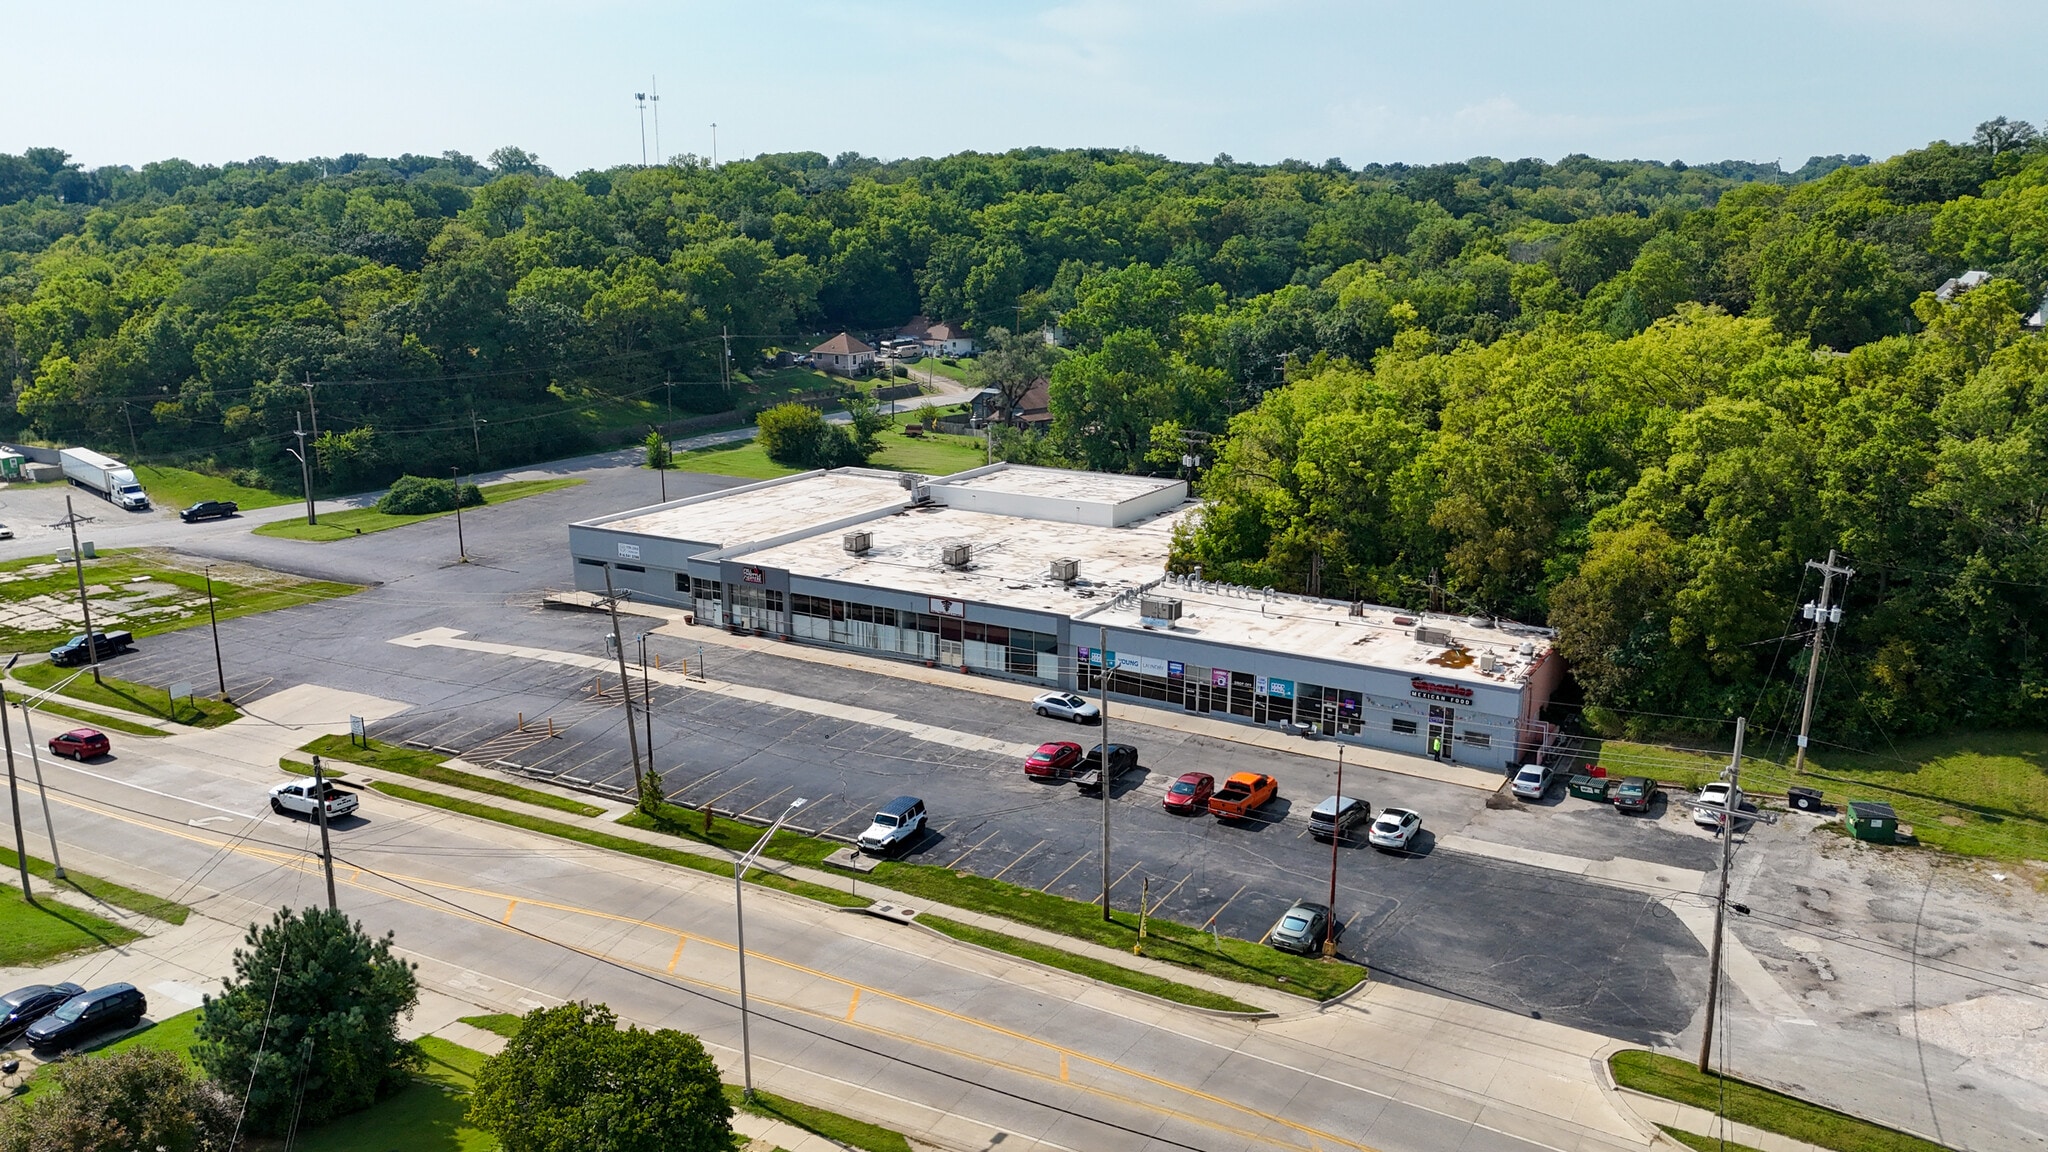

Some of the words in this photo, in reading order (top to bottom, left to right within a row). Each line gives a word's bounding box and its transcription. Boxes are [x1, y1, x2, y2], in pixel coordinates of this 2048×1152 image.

[1118, 658, 1139, 667] YOUNG
[1411, 691, 1446, 701] MEXICAN
[1450, 697, 1470, 705] FOOD
